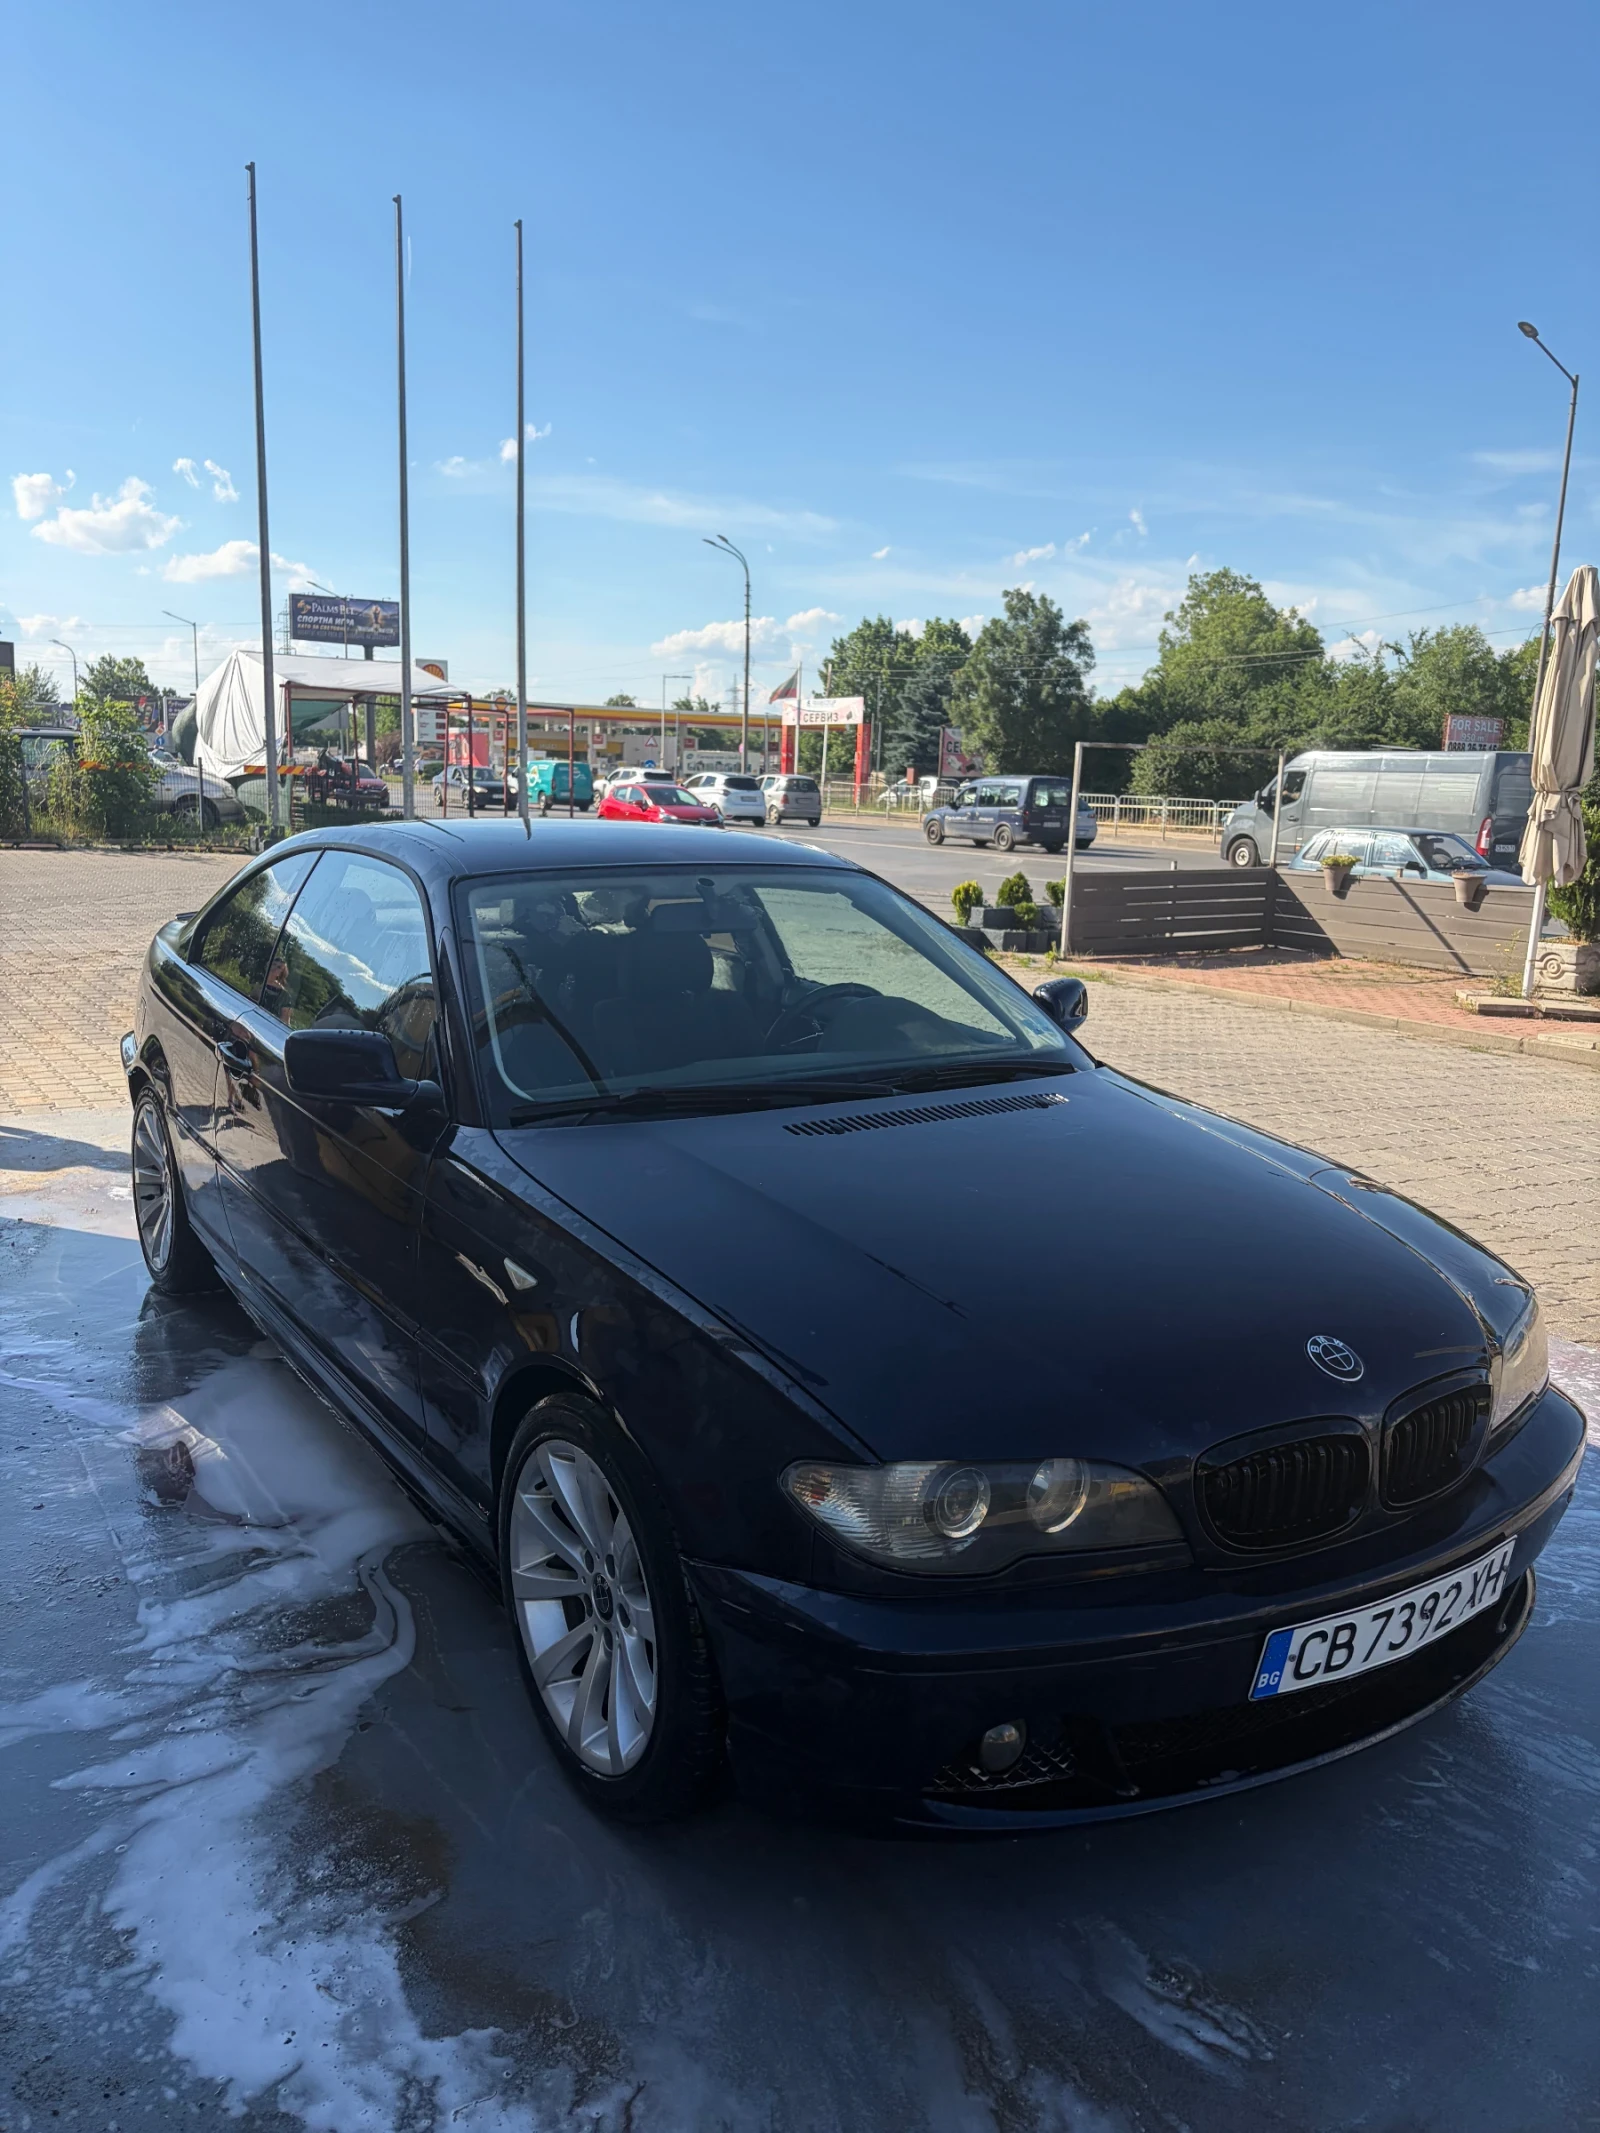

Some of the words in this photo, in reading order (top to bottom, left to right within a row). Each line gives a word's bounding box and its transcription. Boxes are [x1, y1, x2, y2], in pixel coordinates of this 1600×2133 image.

[297, 614, 334, 625] СПОРТНА
[803, 712, 839, 723] СЕРВИЗ
[1450, 718, 1472, 731] FOR
[1473, 720, 1501, 734] SALE
[1310, 1336, 1344, 1354] BMW
[1292, 1621, 1358, 1681] CB
[1361, 1581, 1462, 1664] 7392
[1459, 1550, 1508, 1617] XH
[1258, 1671, 1280, 1688] BG
